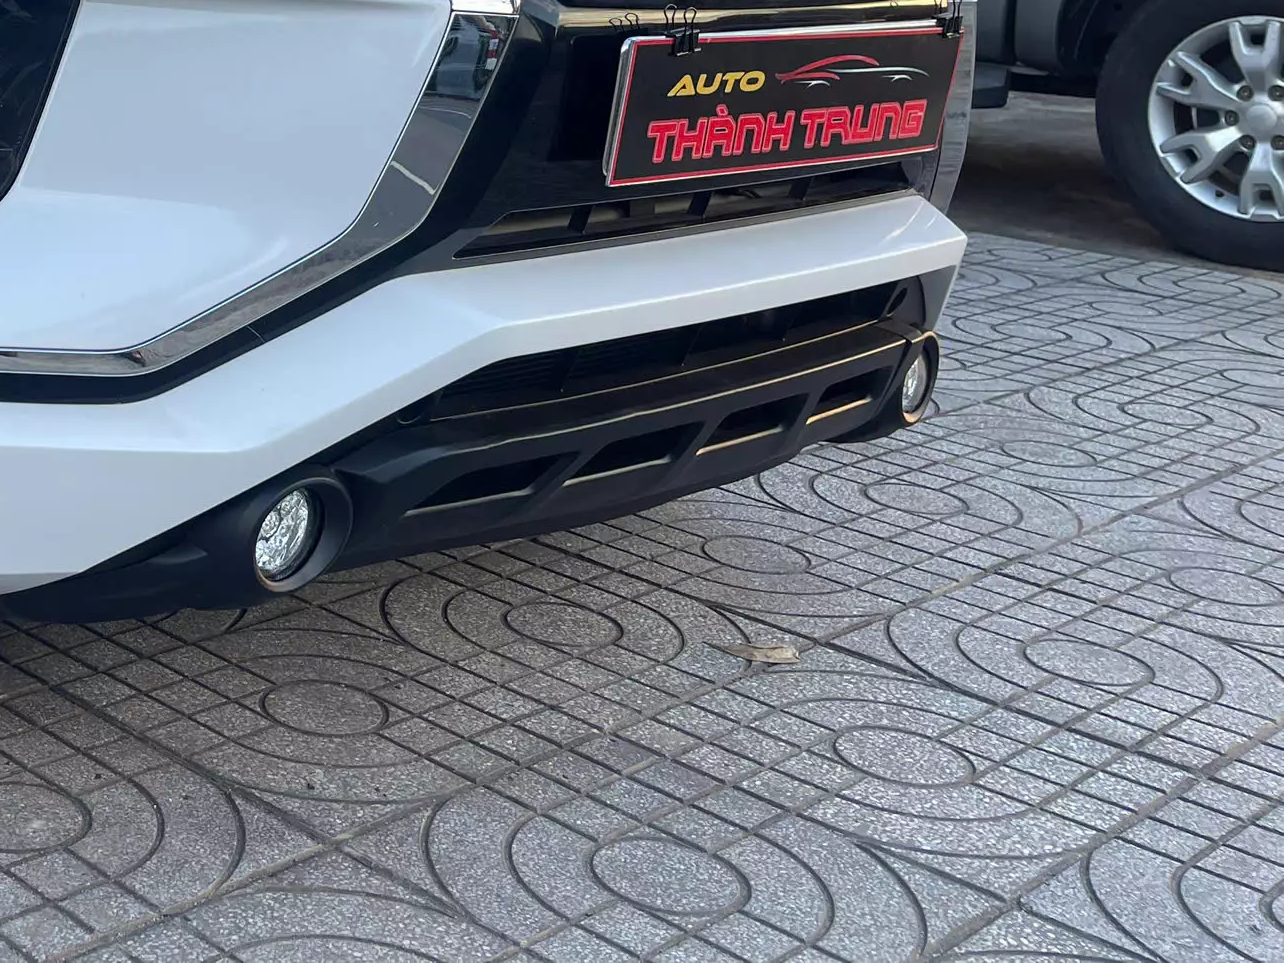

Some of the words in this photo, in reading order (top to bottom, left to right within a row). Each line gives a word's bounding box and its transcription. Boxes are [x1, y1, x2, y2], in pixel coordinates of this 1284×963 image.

[667, 70, 766, 97] AUTO
[647, 103, 795, 164] THÀNH
[800, 98, 928, 150] TRUNG
